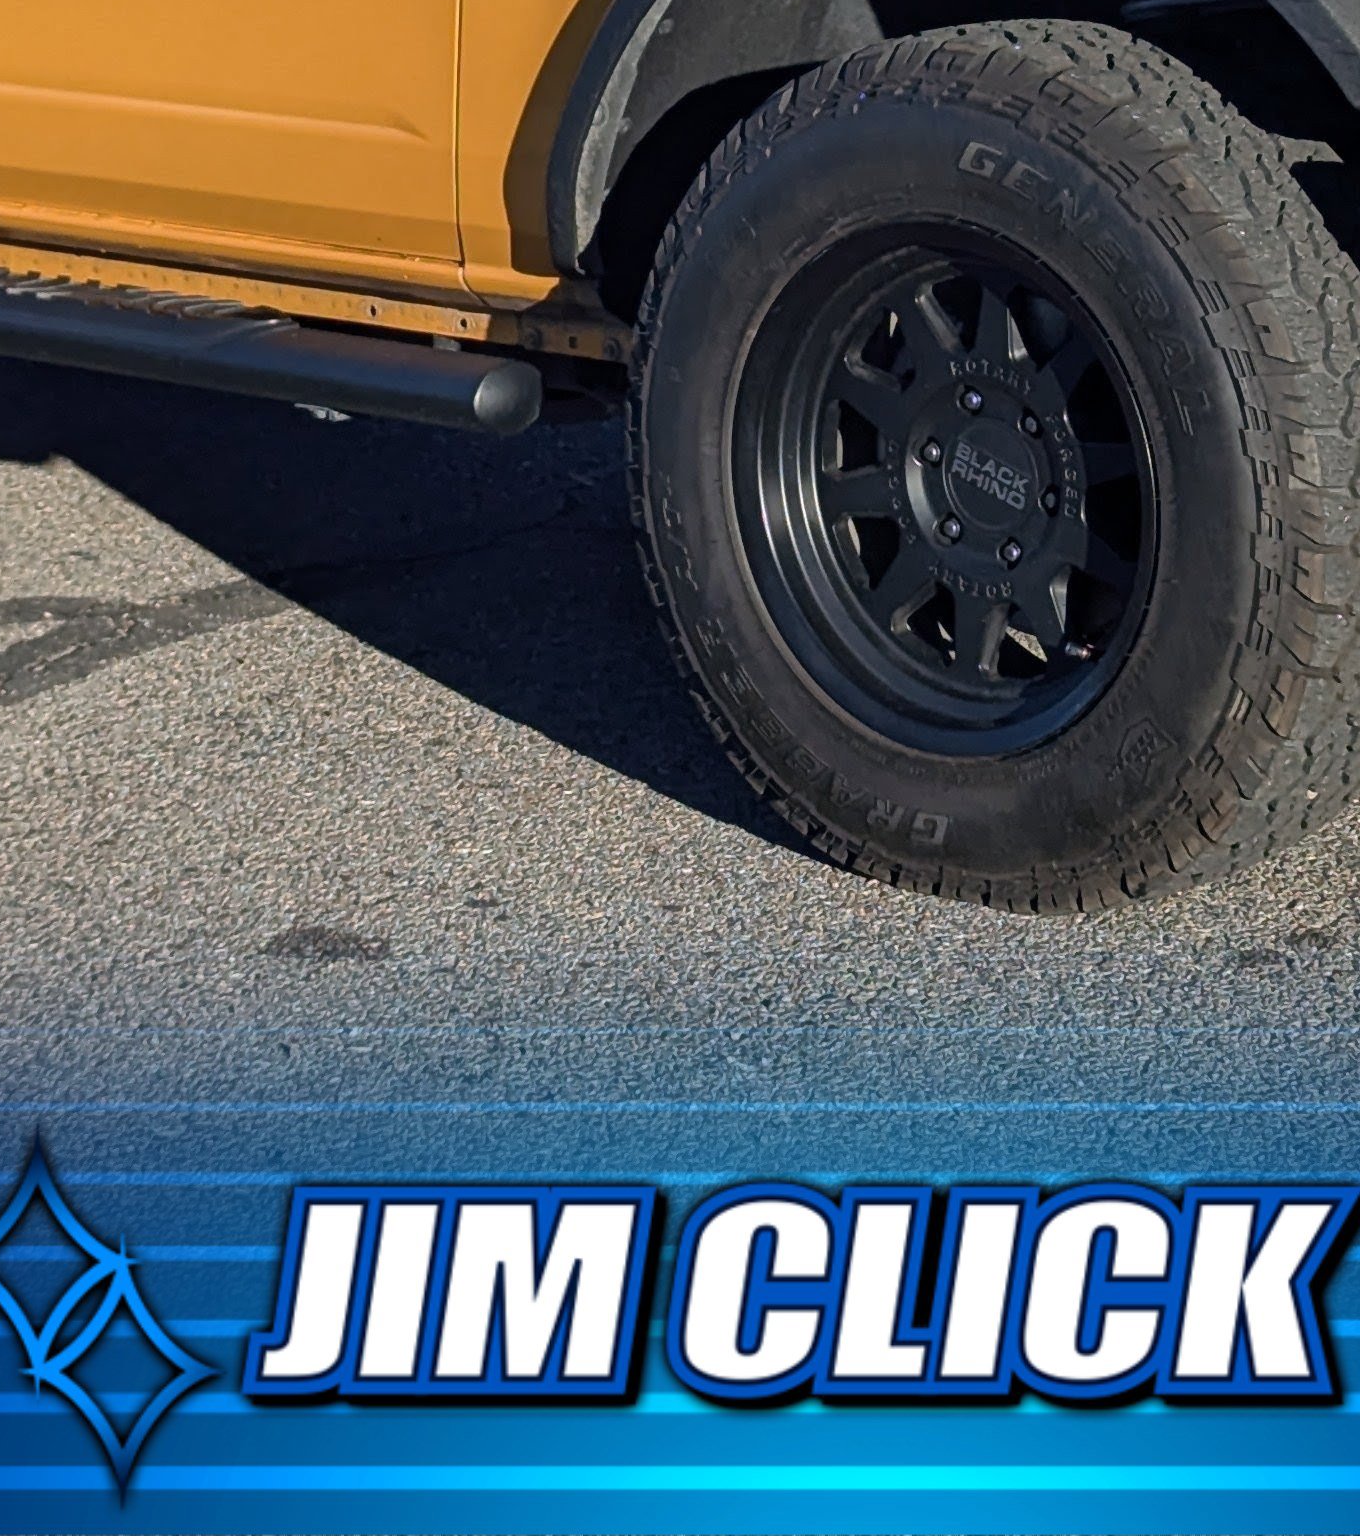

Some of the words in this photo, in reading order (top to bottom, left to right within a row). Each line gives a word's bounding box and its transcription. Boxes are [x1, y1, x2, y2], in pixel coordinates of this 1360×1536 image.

[957, 139, 1211, 437] GENERAL
[951, 459, 1026, 510] RHINO
[955, 441, 1029, 494] BLACK
